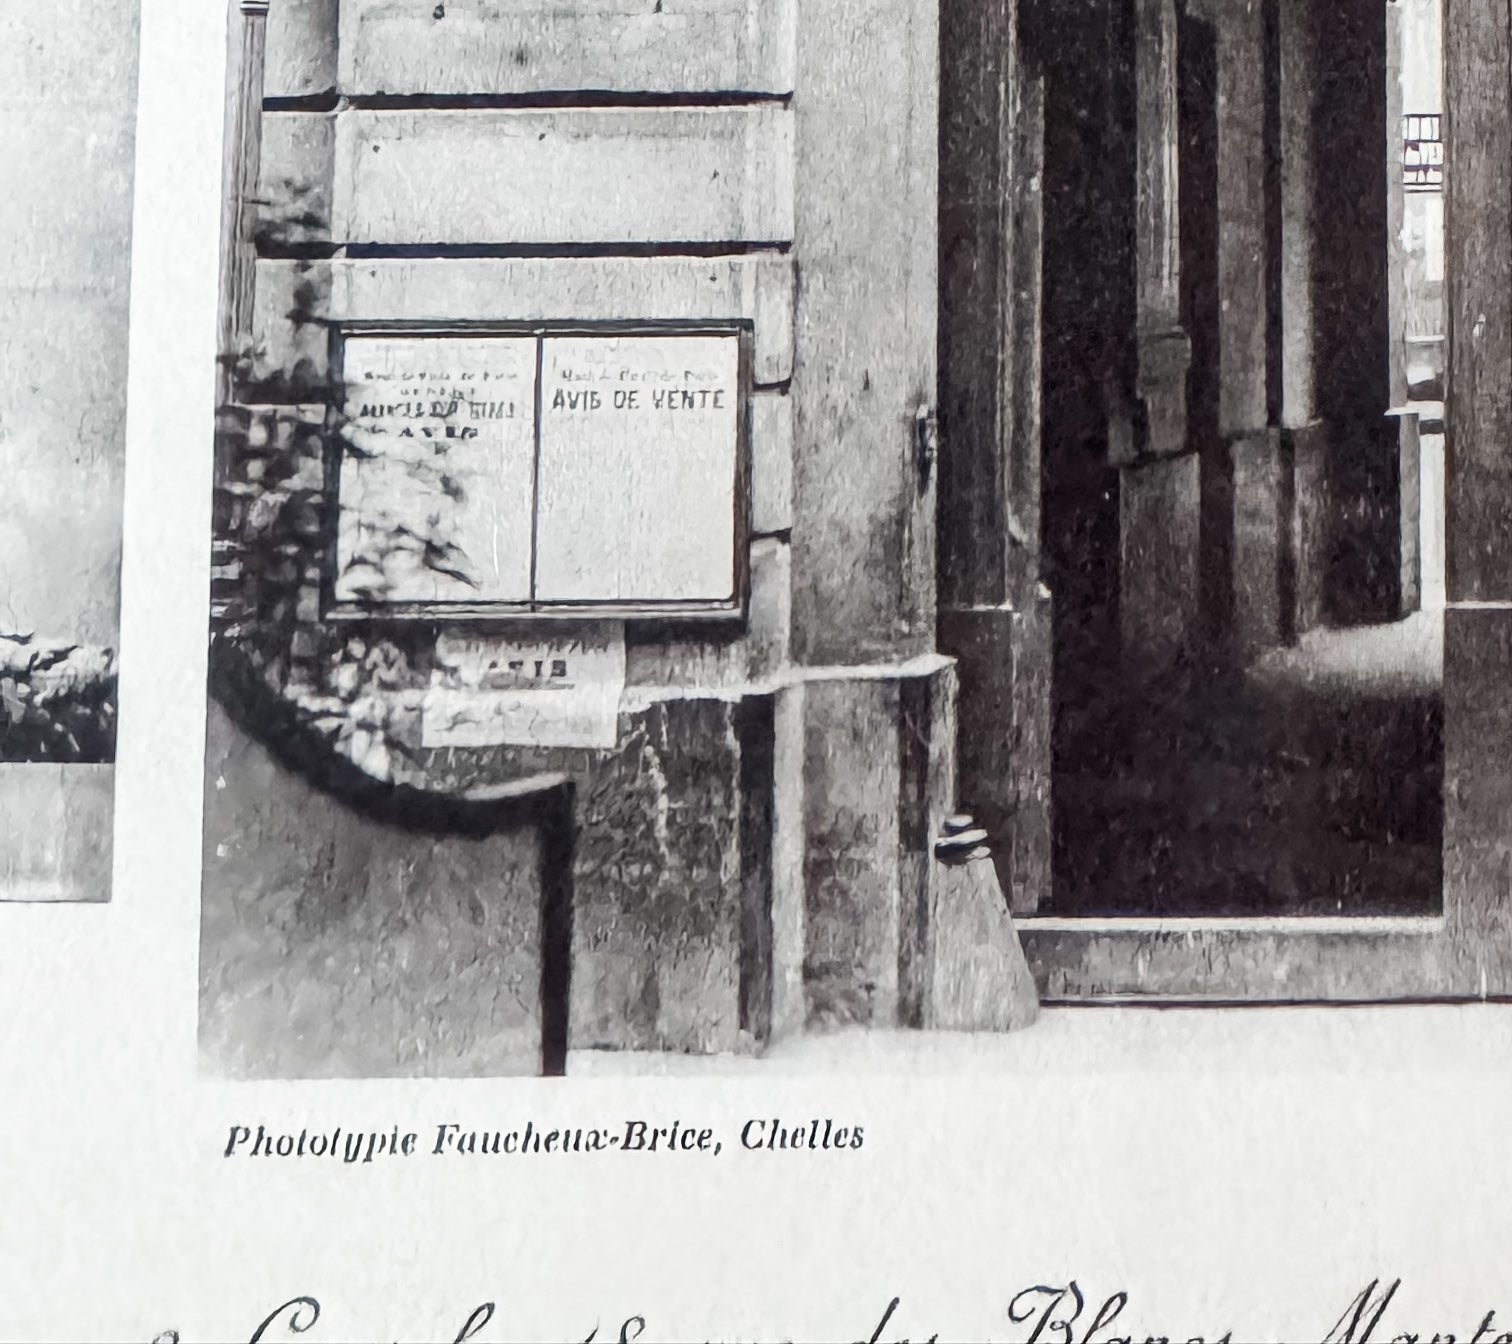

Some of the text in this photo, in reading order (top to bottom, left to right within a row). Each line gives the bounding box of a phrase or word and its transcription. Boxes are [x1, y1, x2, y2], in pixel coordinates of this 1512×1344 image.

[614, 390, 640, 410] DE
[223, 1117, 866, 1164] Phototypie Faucheux-Brice, Chelles
